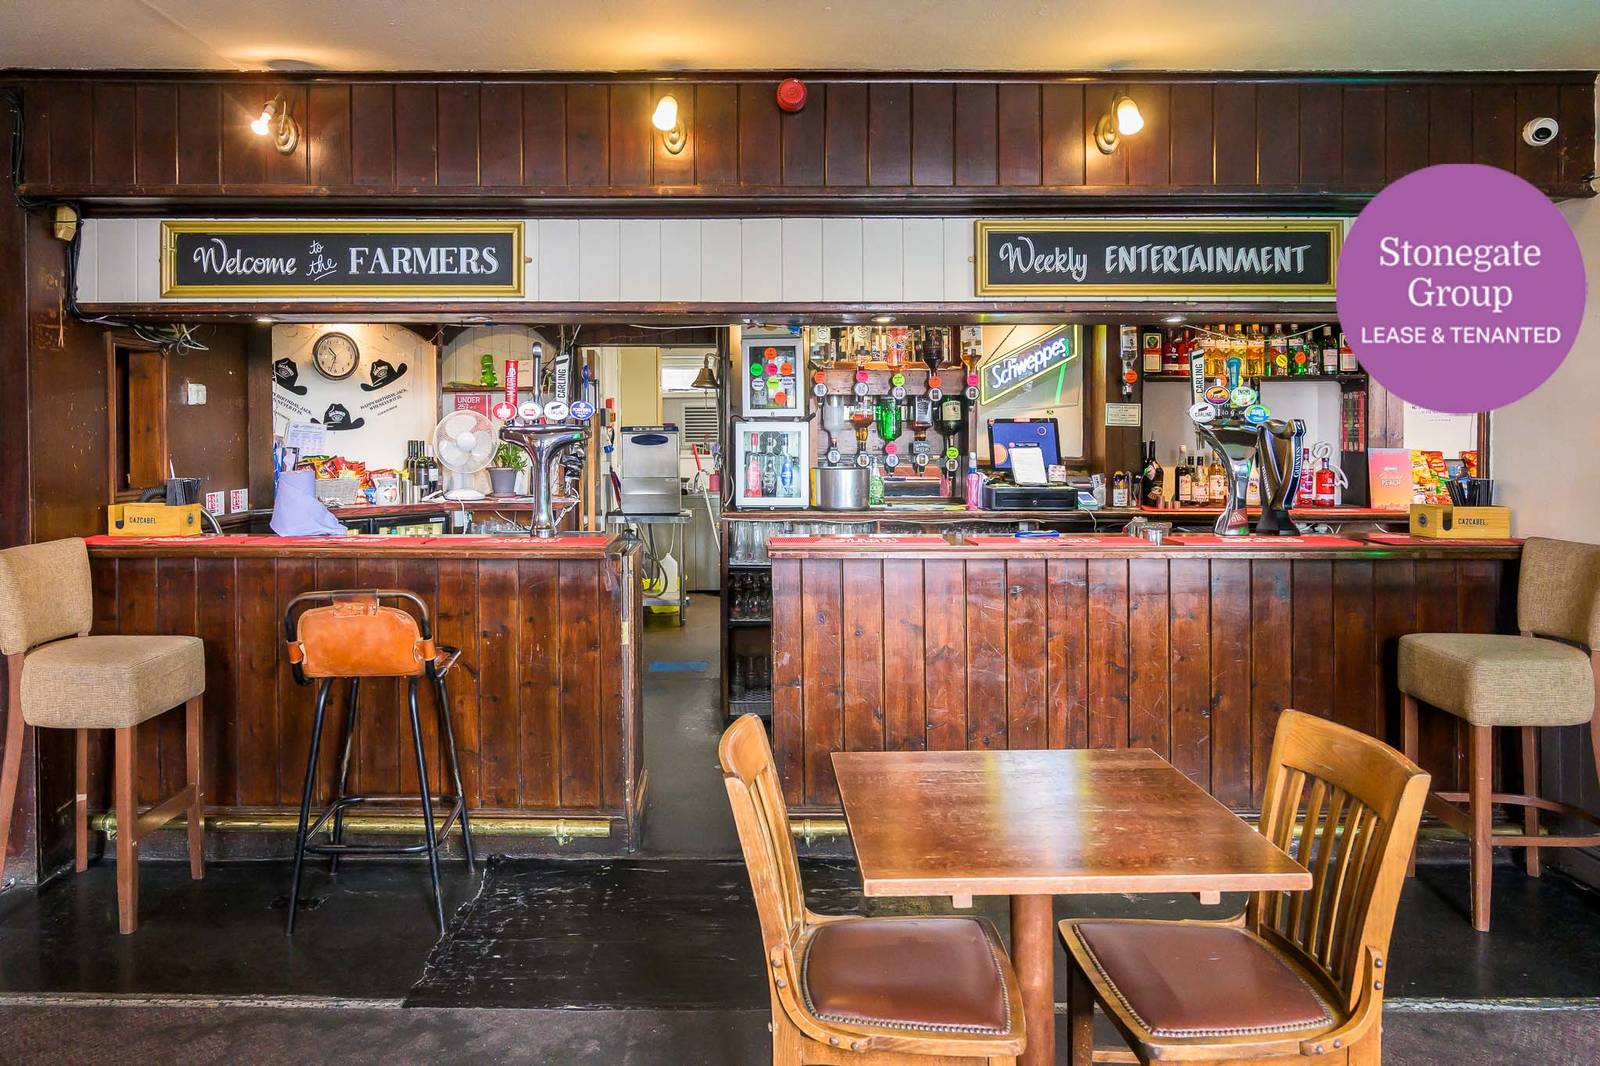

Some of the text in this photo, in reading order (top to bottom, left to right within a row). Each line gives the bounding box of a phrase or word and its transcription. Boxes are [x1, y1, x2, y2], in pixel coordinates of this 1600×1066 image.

[193, 238, 499, 278] Welcome to the FARMERS
[999, 236, 1312, 282] Weekly ENTERTAINMENT
[991, 337, 1067, 389] Schweppes
[1194, 363, 1204, 394] CARLING
[557, 368, 567, 399] CARLING
[457, 396, 480, 404] UNDER
[128, 516, 157, 525] CAZCABEL
